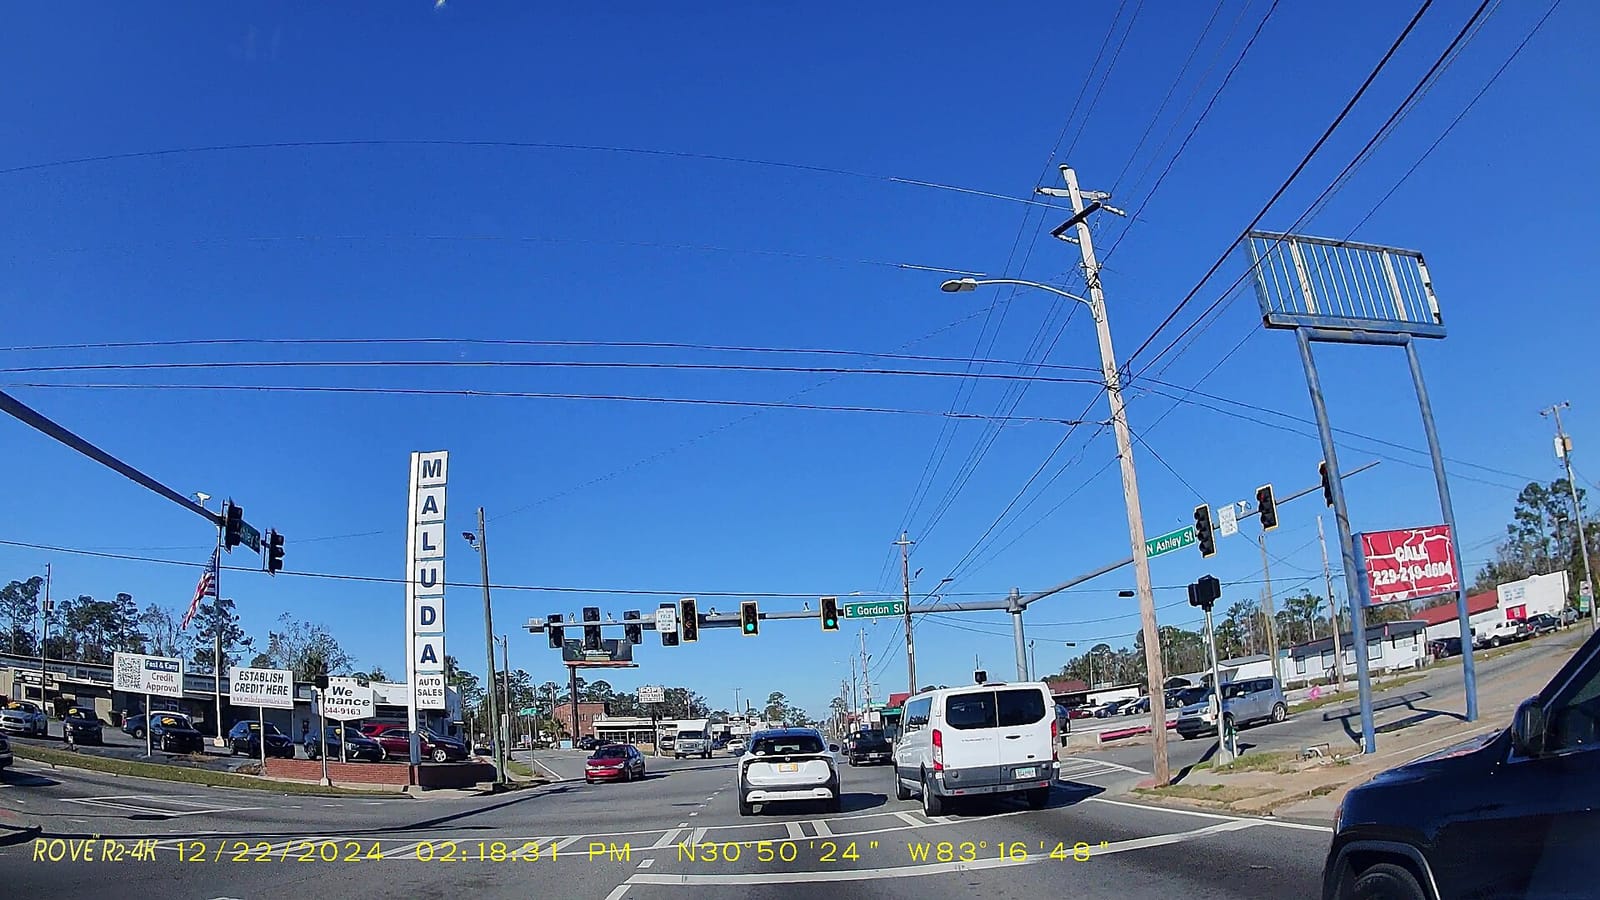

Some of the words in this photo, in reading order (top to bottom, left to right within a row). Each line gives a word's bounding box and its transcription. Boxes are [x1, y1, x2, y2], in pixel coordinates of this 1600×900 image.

[1146, 544, 1154, 556] N
[1156, 536, 1182, 552] Ashley
[1184, 531, 1194, 543] St
[1395, 543, 1428, 562] CALL
[420, 458, 442, 664] MALUDA
[846, 606, 853, 616] E
[857, 601, 889, 615] Gordon
[893, 599, 904, 613] St
[151, 672, 174, 682] Credit
[239, 671, 284, 684] ESTABLISH
[418, 678, 441, 686] AUTO
[146, 682, 179, 693] Approval
[234, 682, 264, 694] CREDIT
[266, 684, 289, 696] HERE
[332, 686, 353, 697] We
[417, 688, 443, 697] SALES
